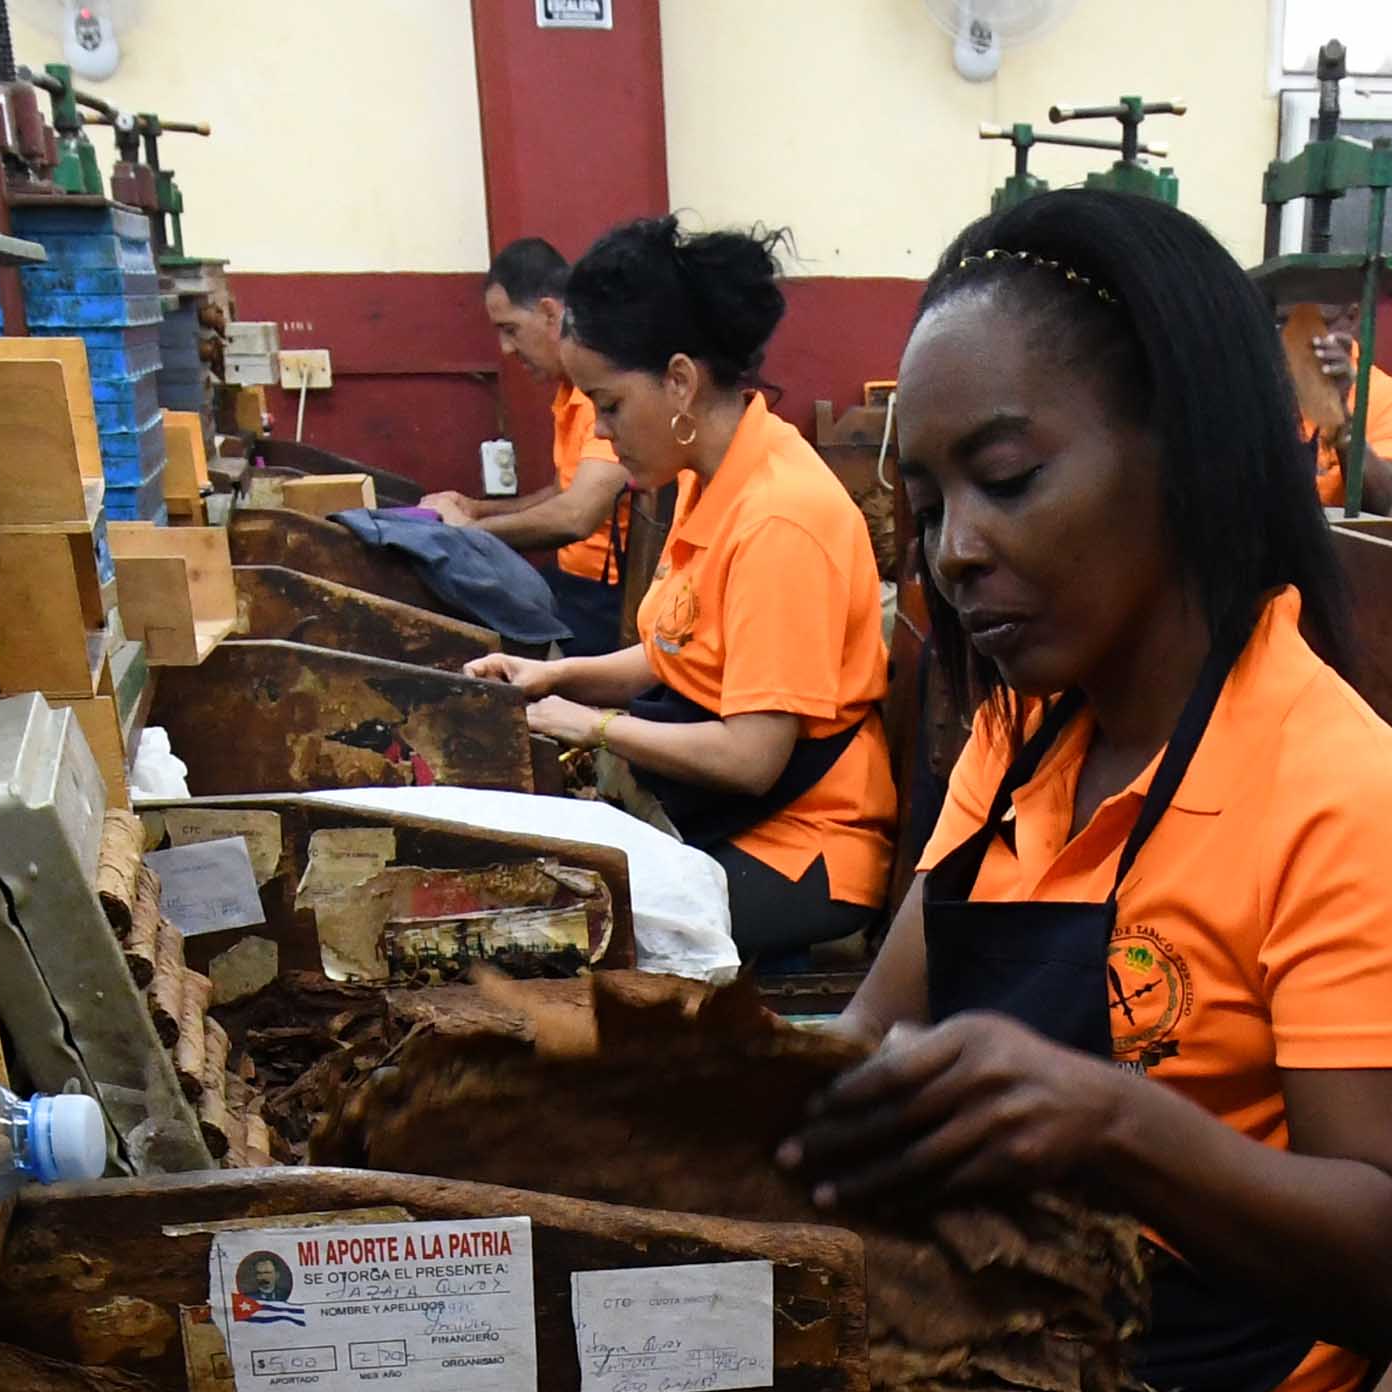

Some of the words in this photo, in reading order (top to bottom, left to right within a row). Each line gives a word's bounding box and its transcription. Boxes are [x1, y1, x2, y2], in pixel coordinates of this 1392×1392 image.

[297, 1240, 321, 1266] MI
[325, 1236, 399, 1266] APORTE
[404, 1235, 418, 1261] A
[420, 1234, 445, 1260] LA
[448, 1231, 513, 1258] PATRIA
[303, 1273, 323, 1285] SE
[327, 1268, 391, 1284] OTORGA
[394, 1266, 412, 1279] EL
[415, 1263, 493, 1278] PRESENTE
[320, 1304, 370, 1317] NOMBRE
[373, 1304, 380, 1313] Y
[382, 1301, 446, 1313] APELLIDOS
[431, 1332, 500, 1344] FINANCIERO
[257, 1359, 266, 1369] $
[441, 1356, 505, 1368] ORGANISMO
[270, 1375, 319, 1385] APORTADO
